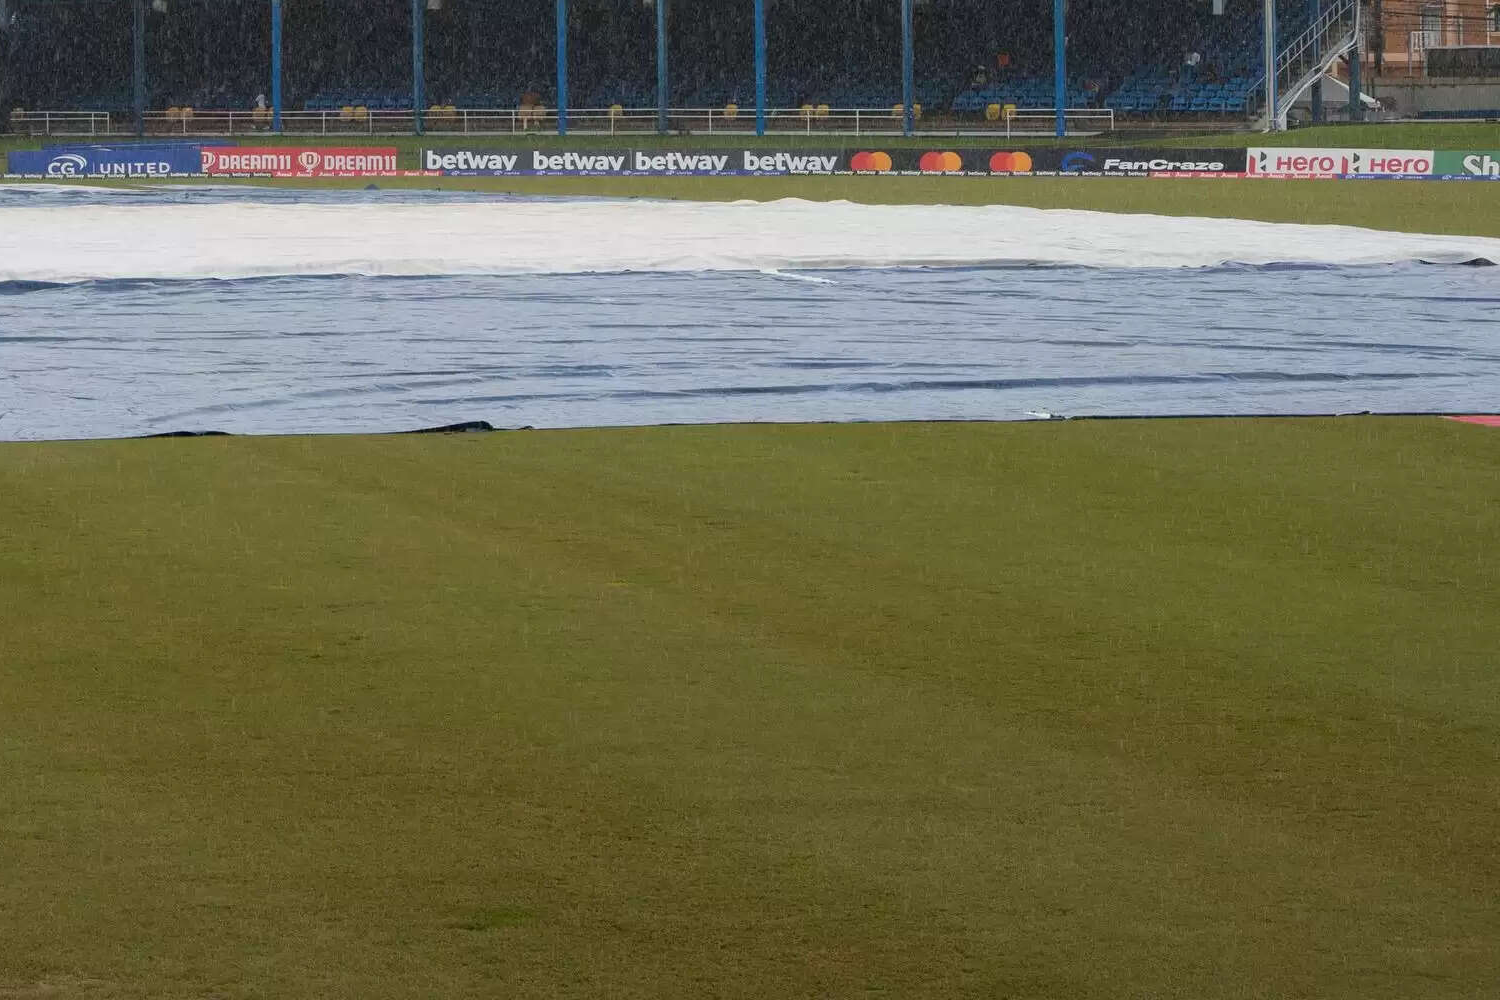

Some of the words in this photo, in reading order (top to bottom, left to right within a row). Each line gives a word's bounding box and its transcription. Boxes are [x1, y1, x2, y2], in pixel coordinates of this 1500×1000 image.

[47, 162, 76, 175] CG
[99, 161, 171, 174] UNITED
[426, 150, 517, 171] betway
[532, 150, 624, 171] betway
[635, 152, 728, 171] betway
[743, 150, 837, 171] betway
[1103, 158, 1225, 171] FanCraze
